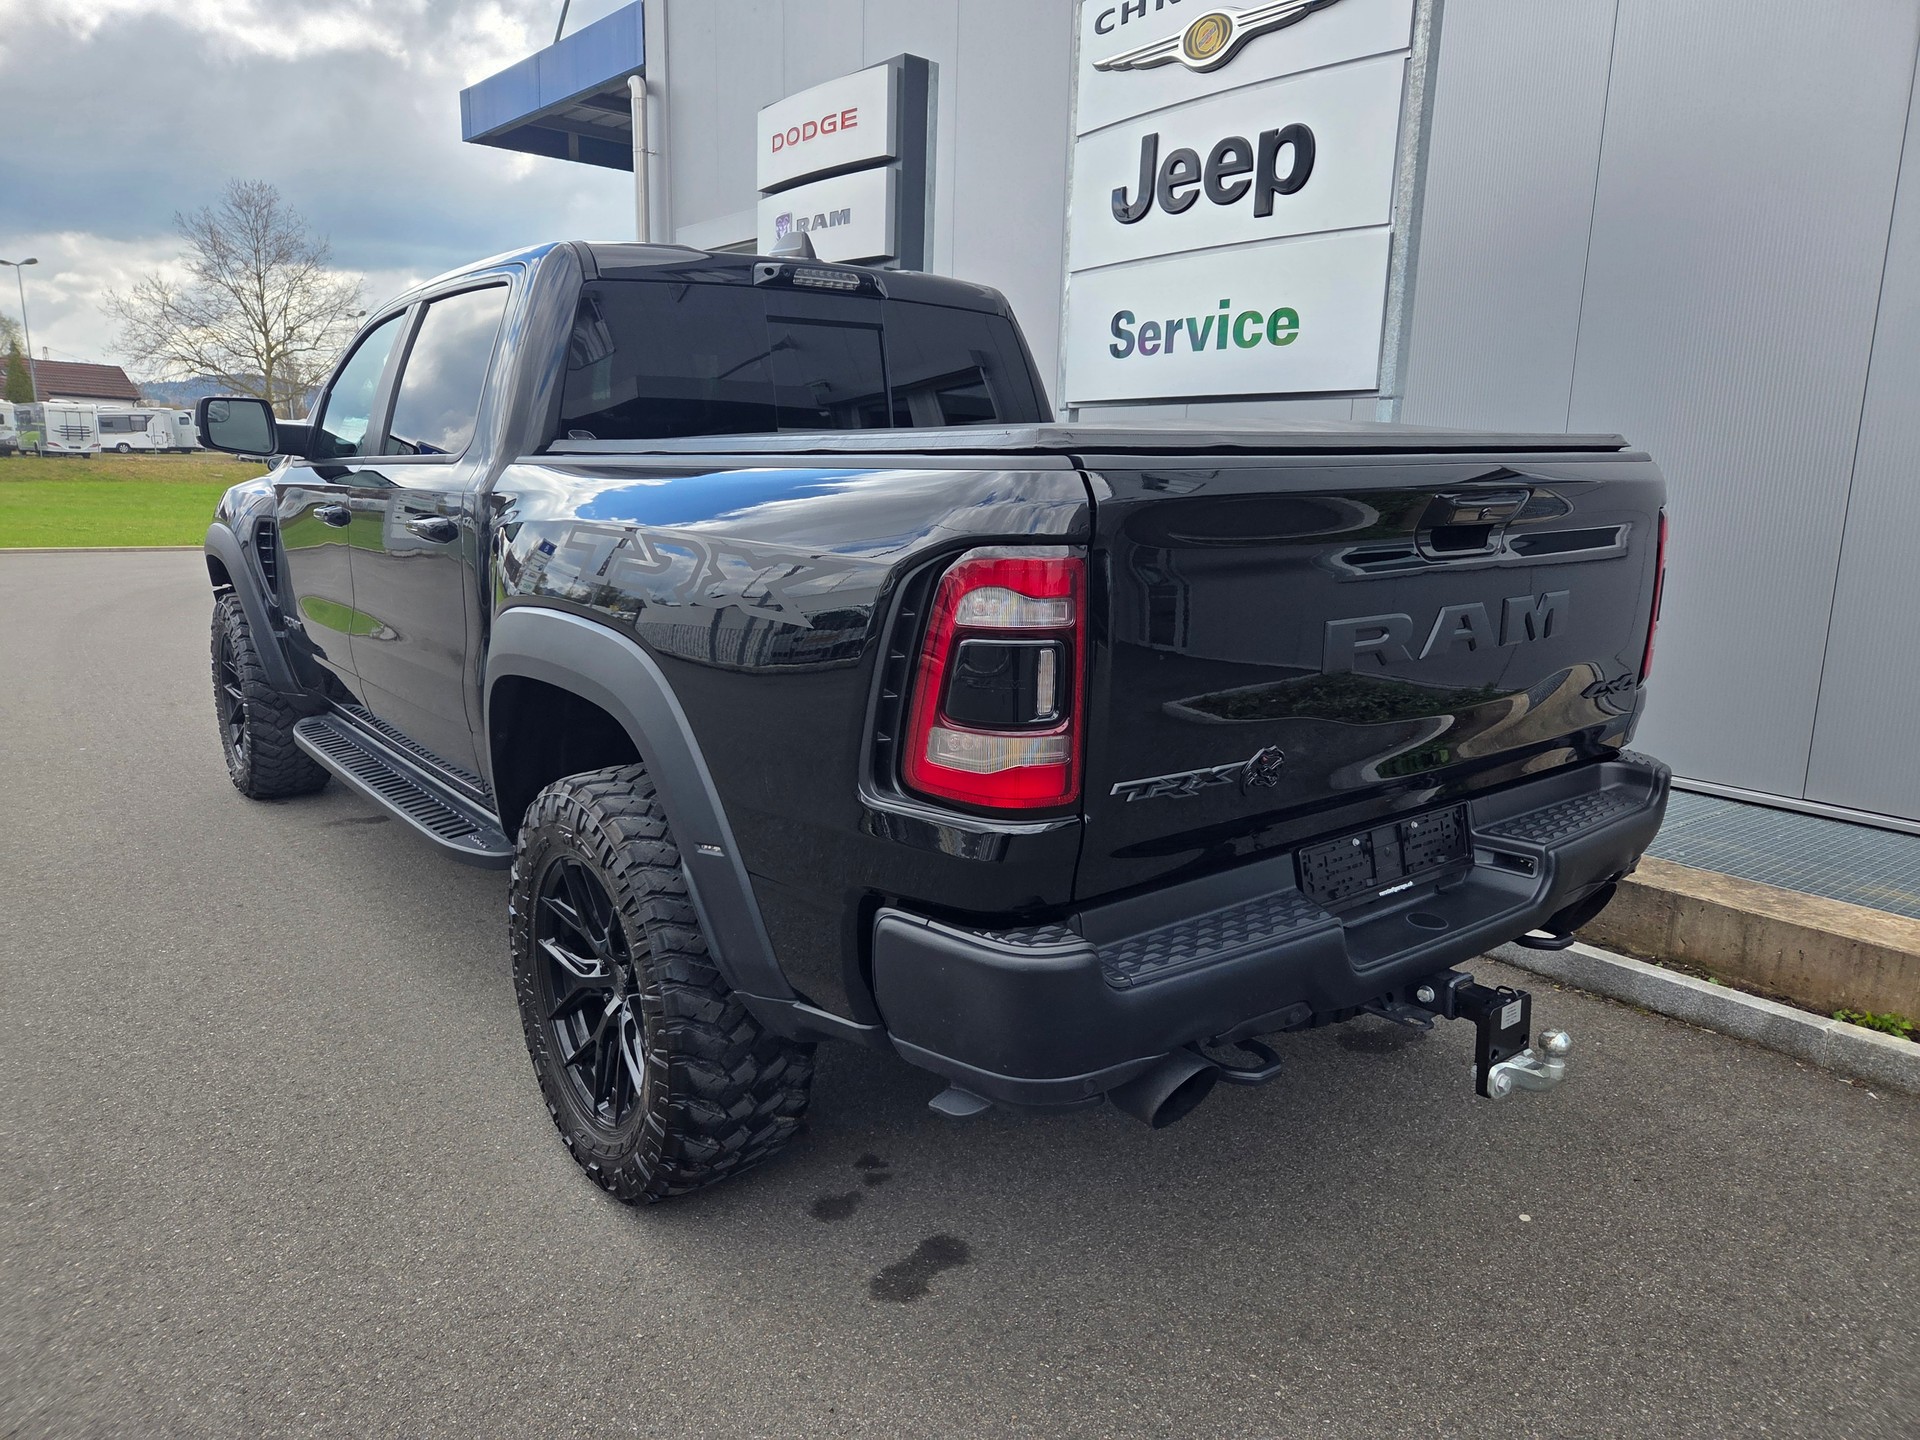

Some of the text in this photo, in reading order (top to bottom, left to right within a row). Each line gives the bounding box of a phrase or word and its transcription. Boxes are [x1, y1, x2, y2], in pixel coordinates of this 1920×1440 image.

[772, 107, 858, 153] DODGE
[1111, 122, 1316, 225] Jeep
[796, 207, 851, 233] RAM
[1109, 298, 1300, 360] Service
[1321, 589, 1570, 675] RAM
[1109, 759, 1250, 803] TRX
